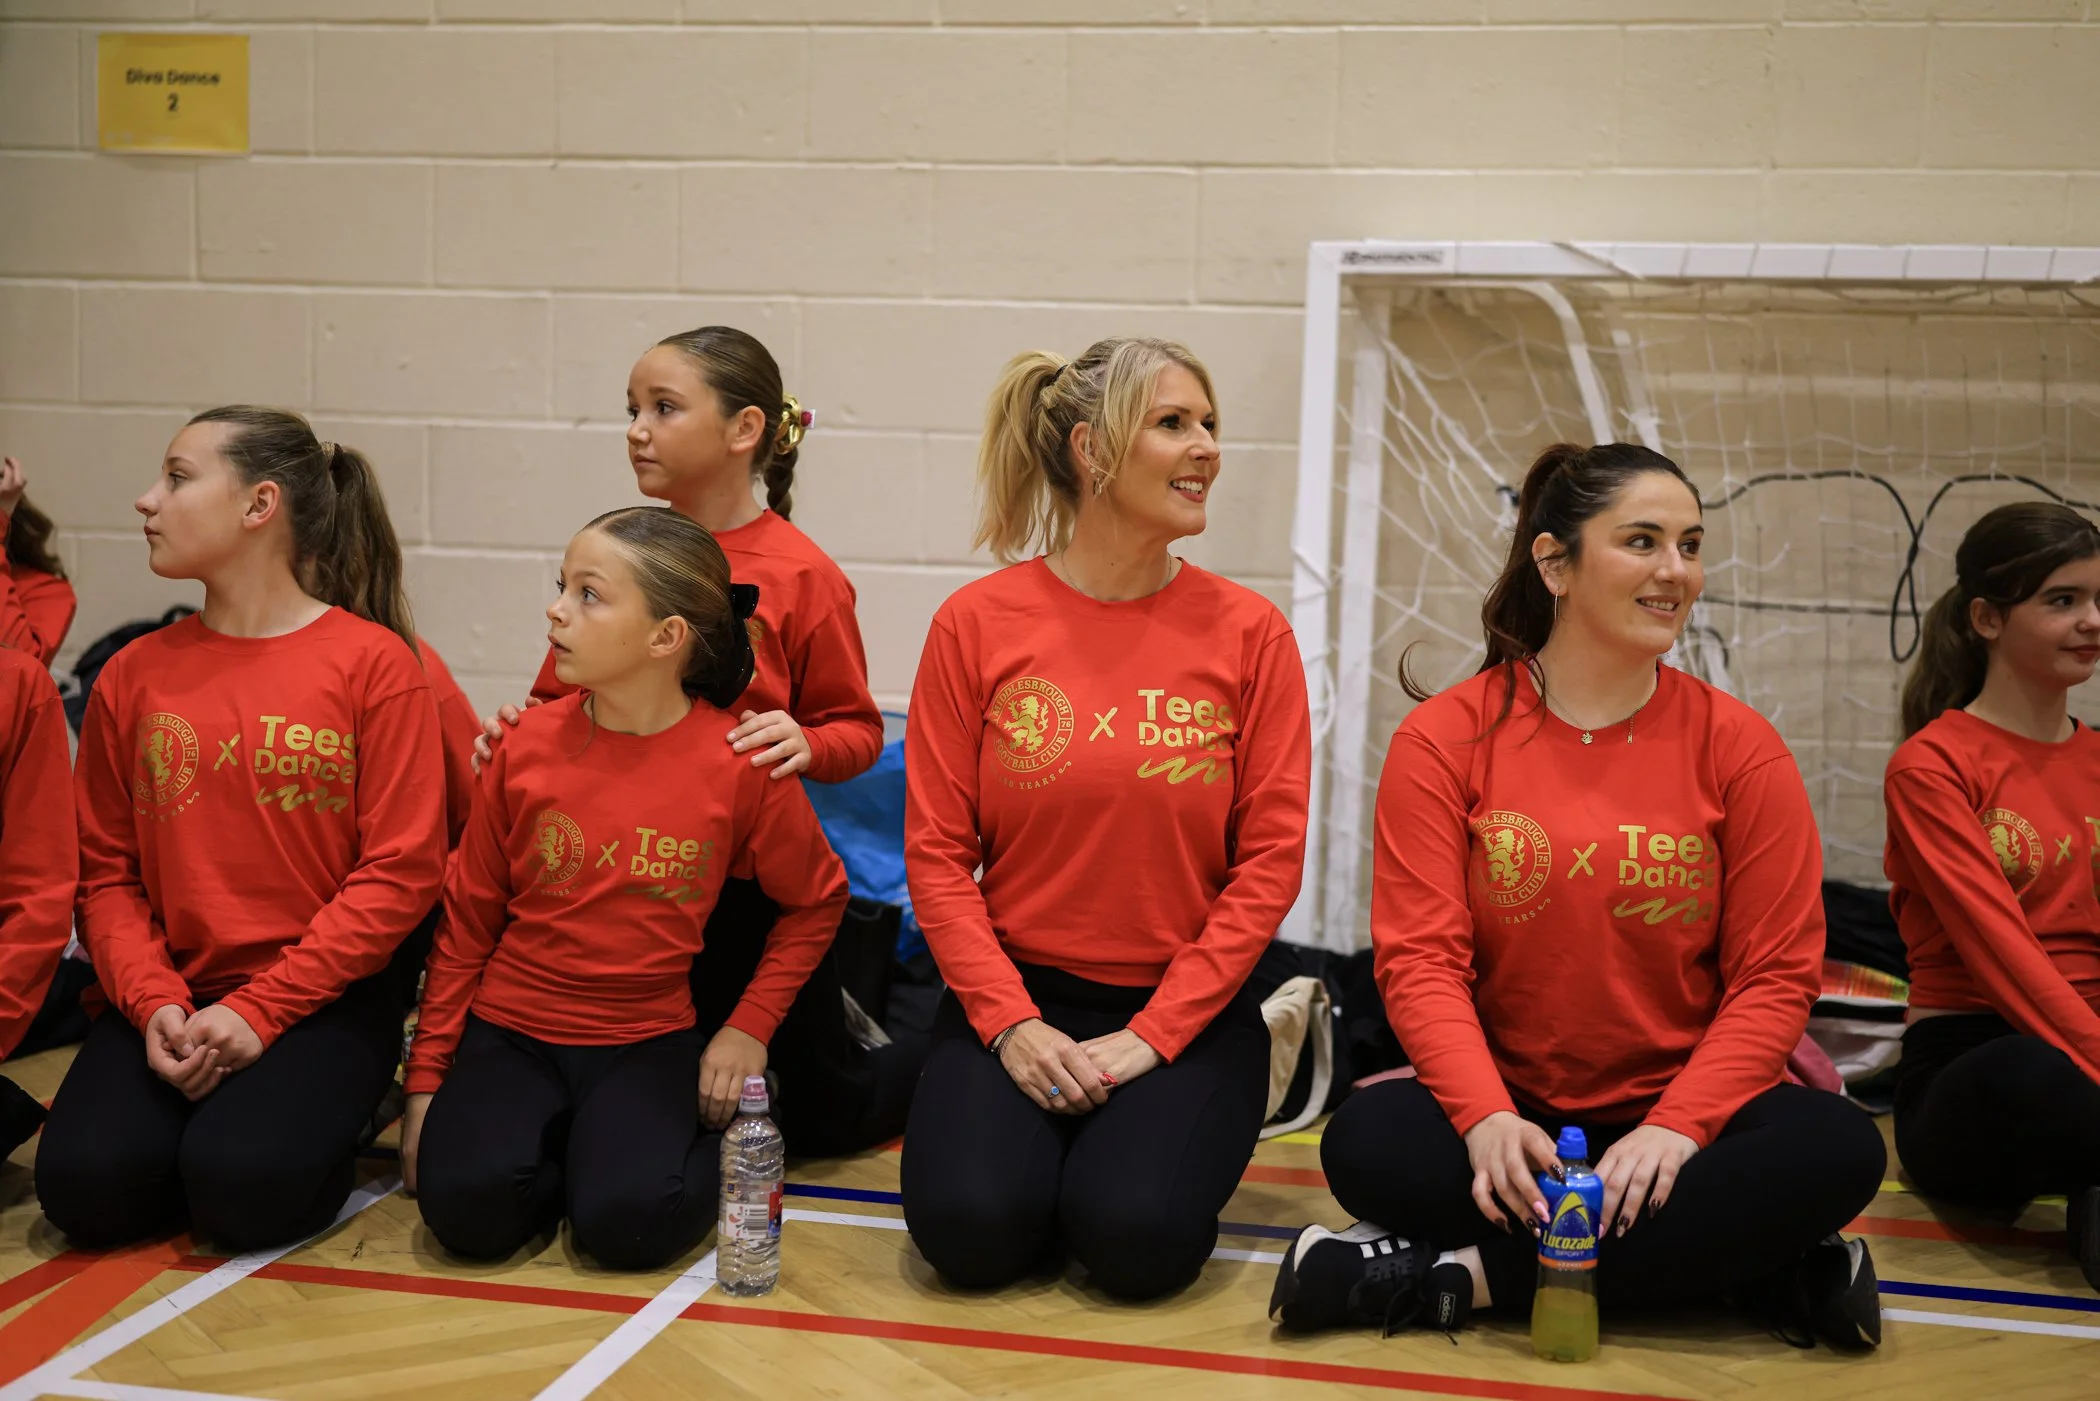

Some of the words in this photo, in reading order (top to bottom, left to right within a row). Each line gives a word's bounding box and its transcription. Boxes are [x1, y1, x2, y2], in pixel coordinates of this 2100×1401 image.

[126, 68, 163, 84] Diva
[167, 69, 220, 85] Dance
[167, 93, 179, 112] 2
[992, 679, 1070, 717] MIDDLESBROUGH
[1137, 689, 1233, 730] Tees
[259, 715, 356, 760] Tees
[1138, 721, 1227, 751] Danc
[186, 750, 196, 758] 76
[254, 749, 355, 784] Dance
[996, 738, 1039, 769] FOOTBALL
[1041, 736, 1066, 763] CLUB
[169, 766, 194, 794] CLUB
[1020, 774, 1056, 790] YEARS
[636, 827, 714, 861] Tees
[1476, 813, 1547, 850] DLESBROUGH
[559, 861, 579, 880] CLUB
[1519, 871, 1544, 899] CLUB
[1542, 1229, 1596, 1250] Lucozade
